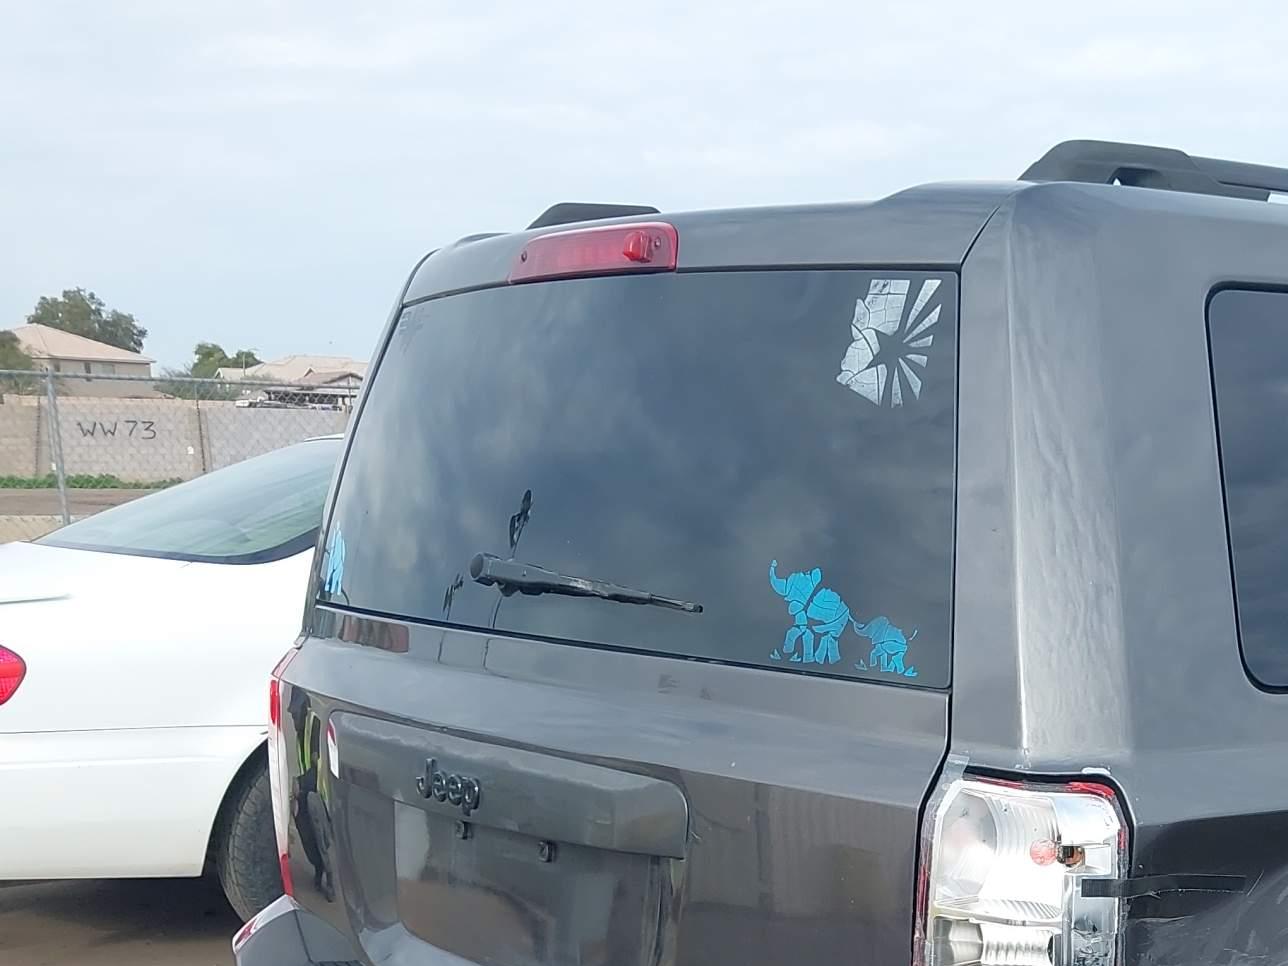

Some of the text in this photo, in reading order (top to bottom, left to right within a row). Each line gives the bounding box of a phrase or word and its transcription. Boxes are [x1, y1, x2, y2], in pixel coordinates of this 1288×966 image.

[77, 420, 157, 440] WW 73
[416, 757, 480, 817] Jeep
